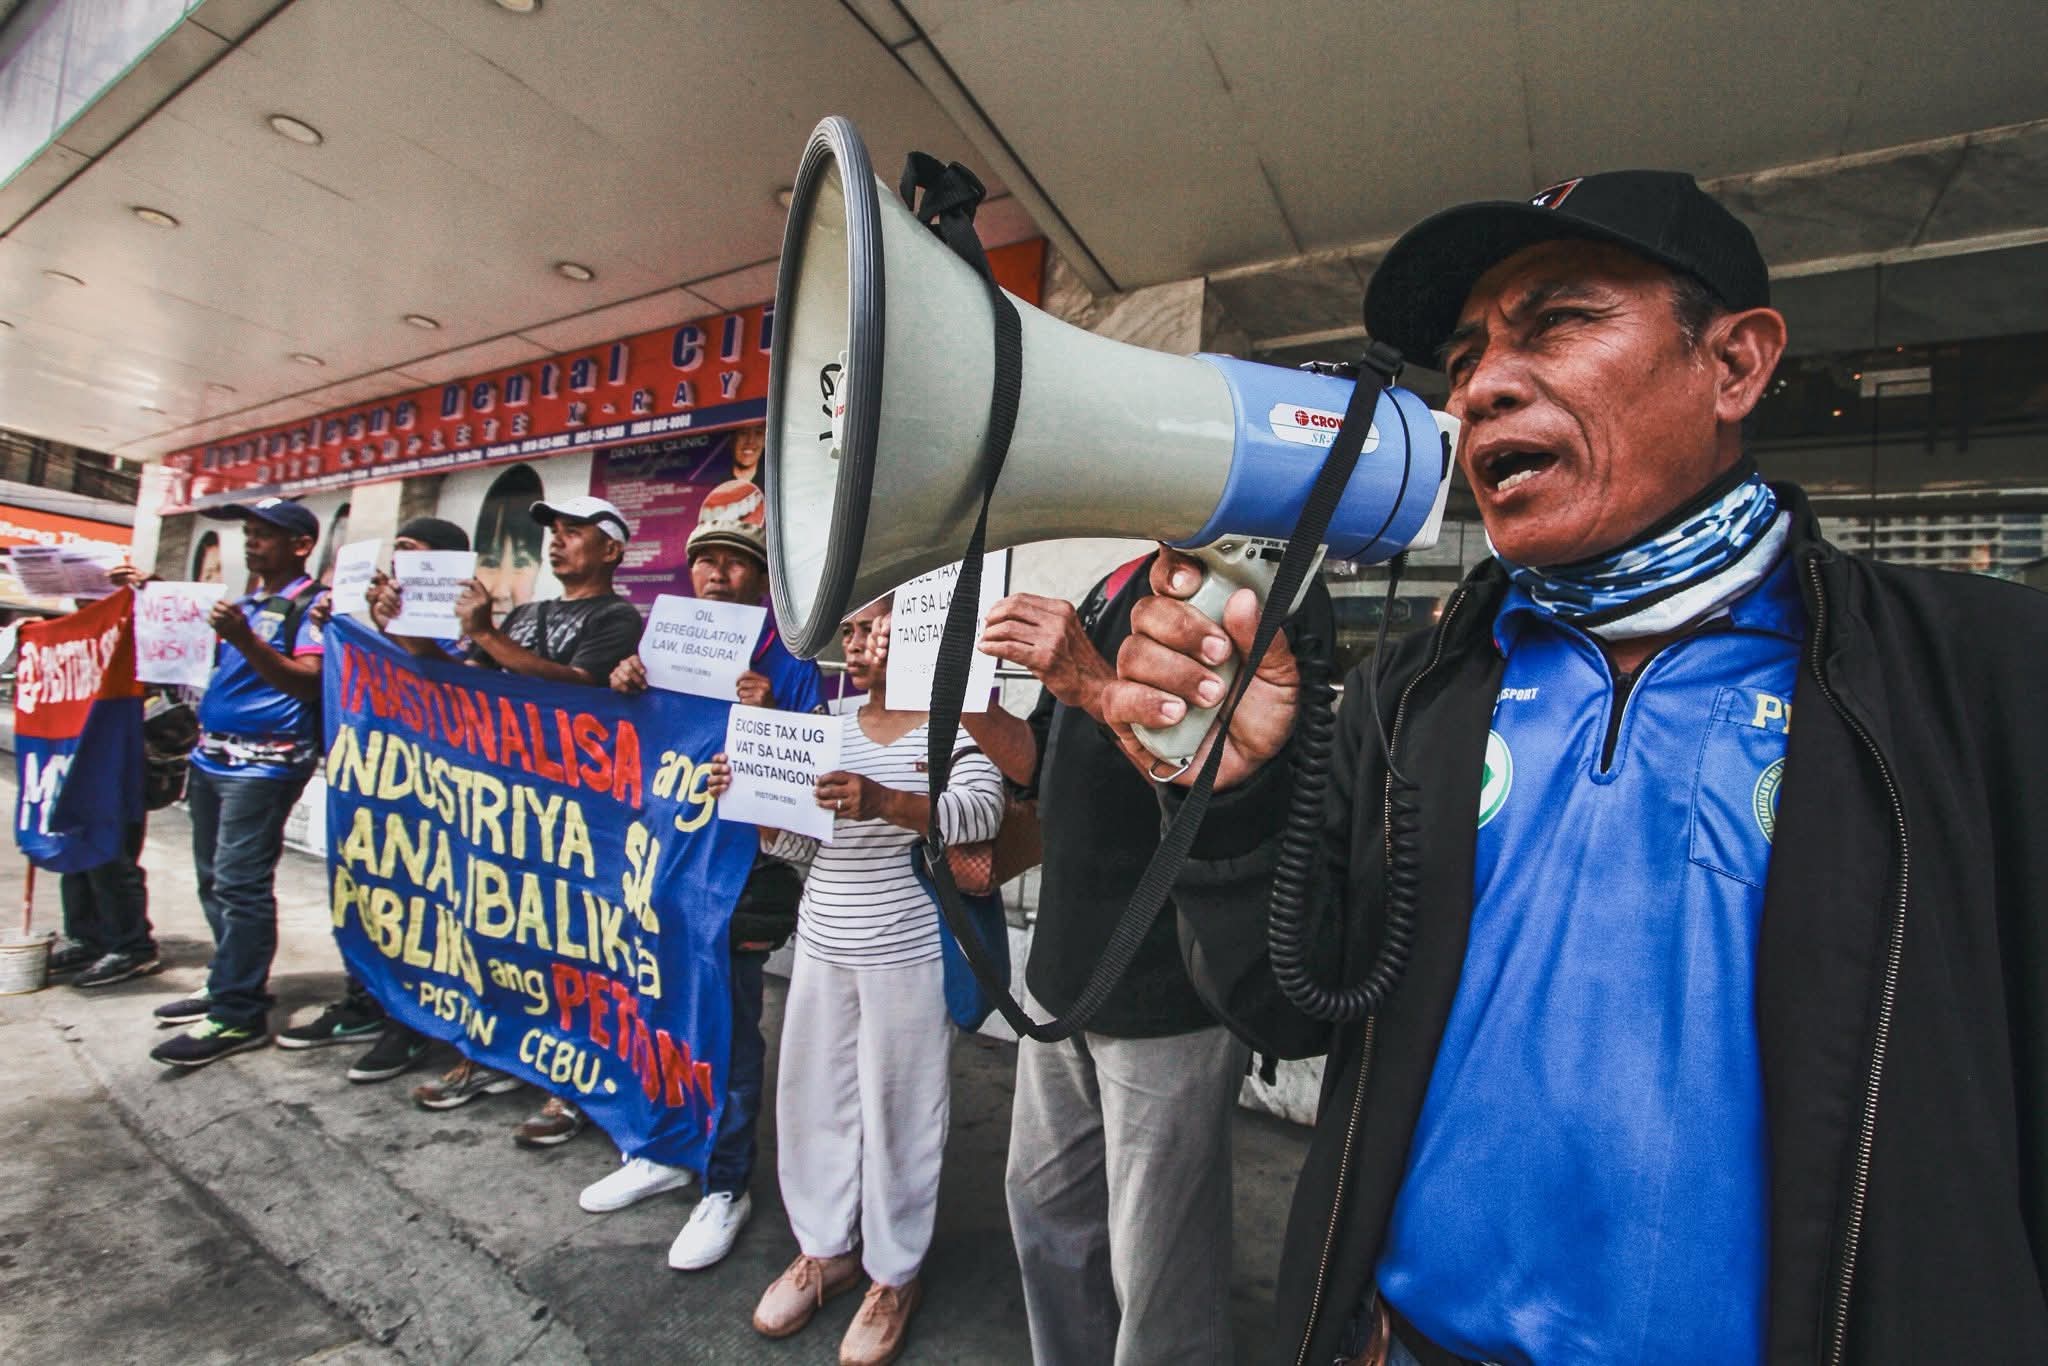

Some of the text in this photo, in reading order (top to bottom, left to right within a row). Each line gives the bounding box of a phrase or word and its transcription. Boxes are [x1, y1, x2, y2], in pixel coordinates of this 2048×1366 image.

[695, 609, 715, 623] OIL
[655, 621, 747, 645] DEREGULATION
[652, 638, 739, 661] LAW, IBASURA!
[1500, 687, 1540, 701] SPORT
[735, 718, 825, 744] EXCISE TAX UG
[735, 739, 816, 767] VAT SA LANA,
[326, 723, 596, 879] INDUSTRIYA
[652, 749, 717, 832] ang
[463, 852, 638, 974] IBALIK
[487, 958, 550, 1016] ang
